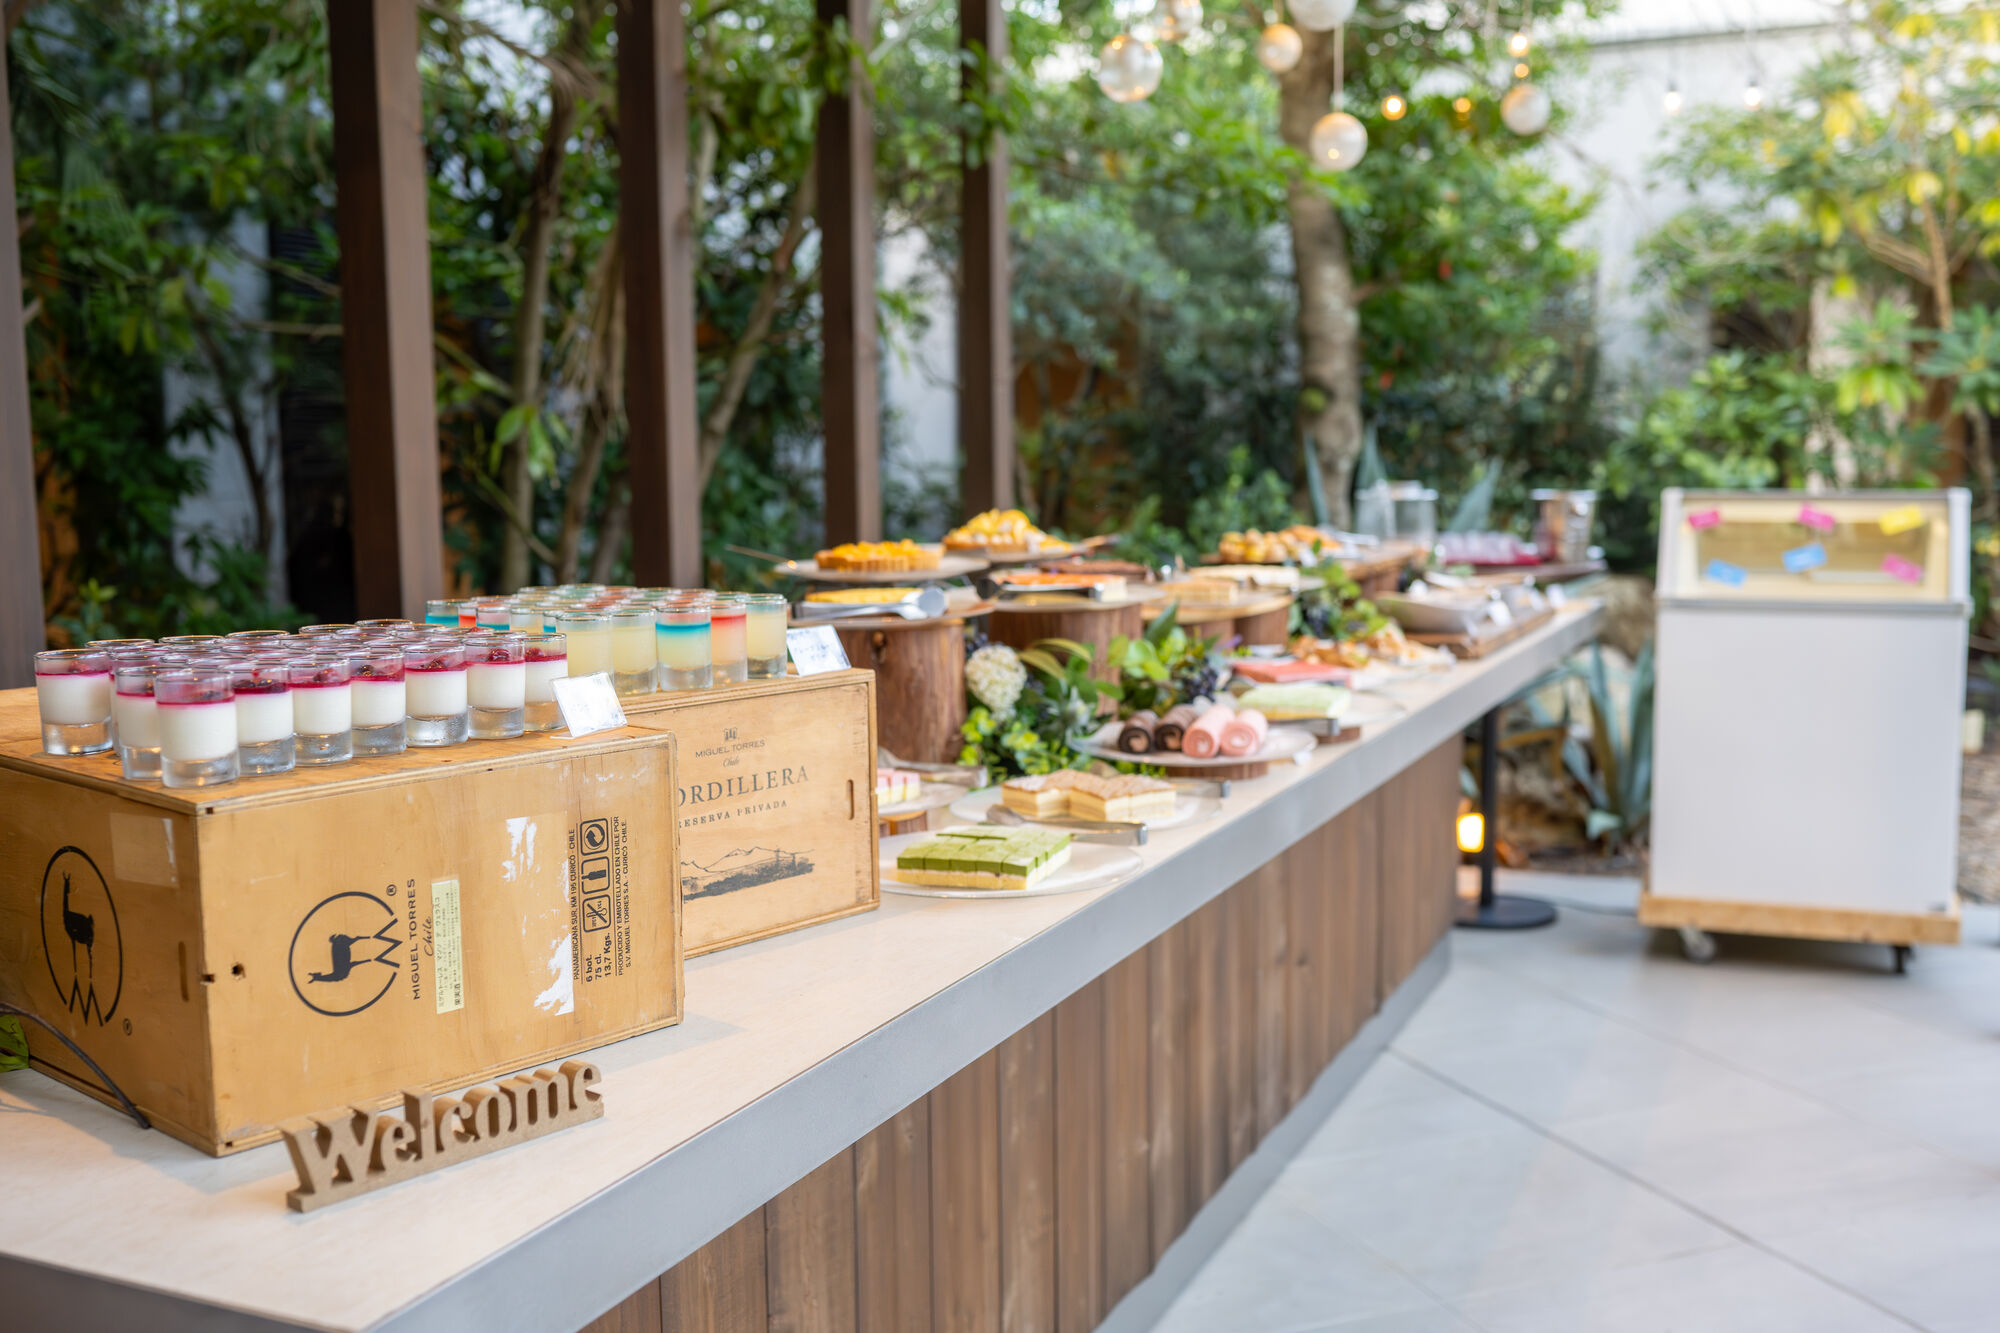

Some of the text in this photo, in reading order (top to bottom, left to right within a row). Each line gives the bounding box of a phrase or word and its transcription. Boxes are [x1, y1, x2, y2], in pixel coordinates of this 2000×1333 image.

[695, 739, 765, 758] MIGUEL TORRES
[678, 765, 809, 807] RDILLERA
[737, 799, 787, 816] PRIVADA
[615, 856, 621, 868] EN
[570, 896, 577, 908] KM
[407, 878, 420, 1000] MIGUEL TORRES
[422, 916, 433, 957] Chile
[572, 925, 580, 980] PANAMERICANA
[603, 932, 612, 977] 13,7 Kgs.
[595, 966, 602, 980] 75
[278, 1060, 604, 1212] Welcome
